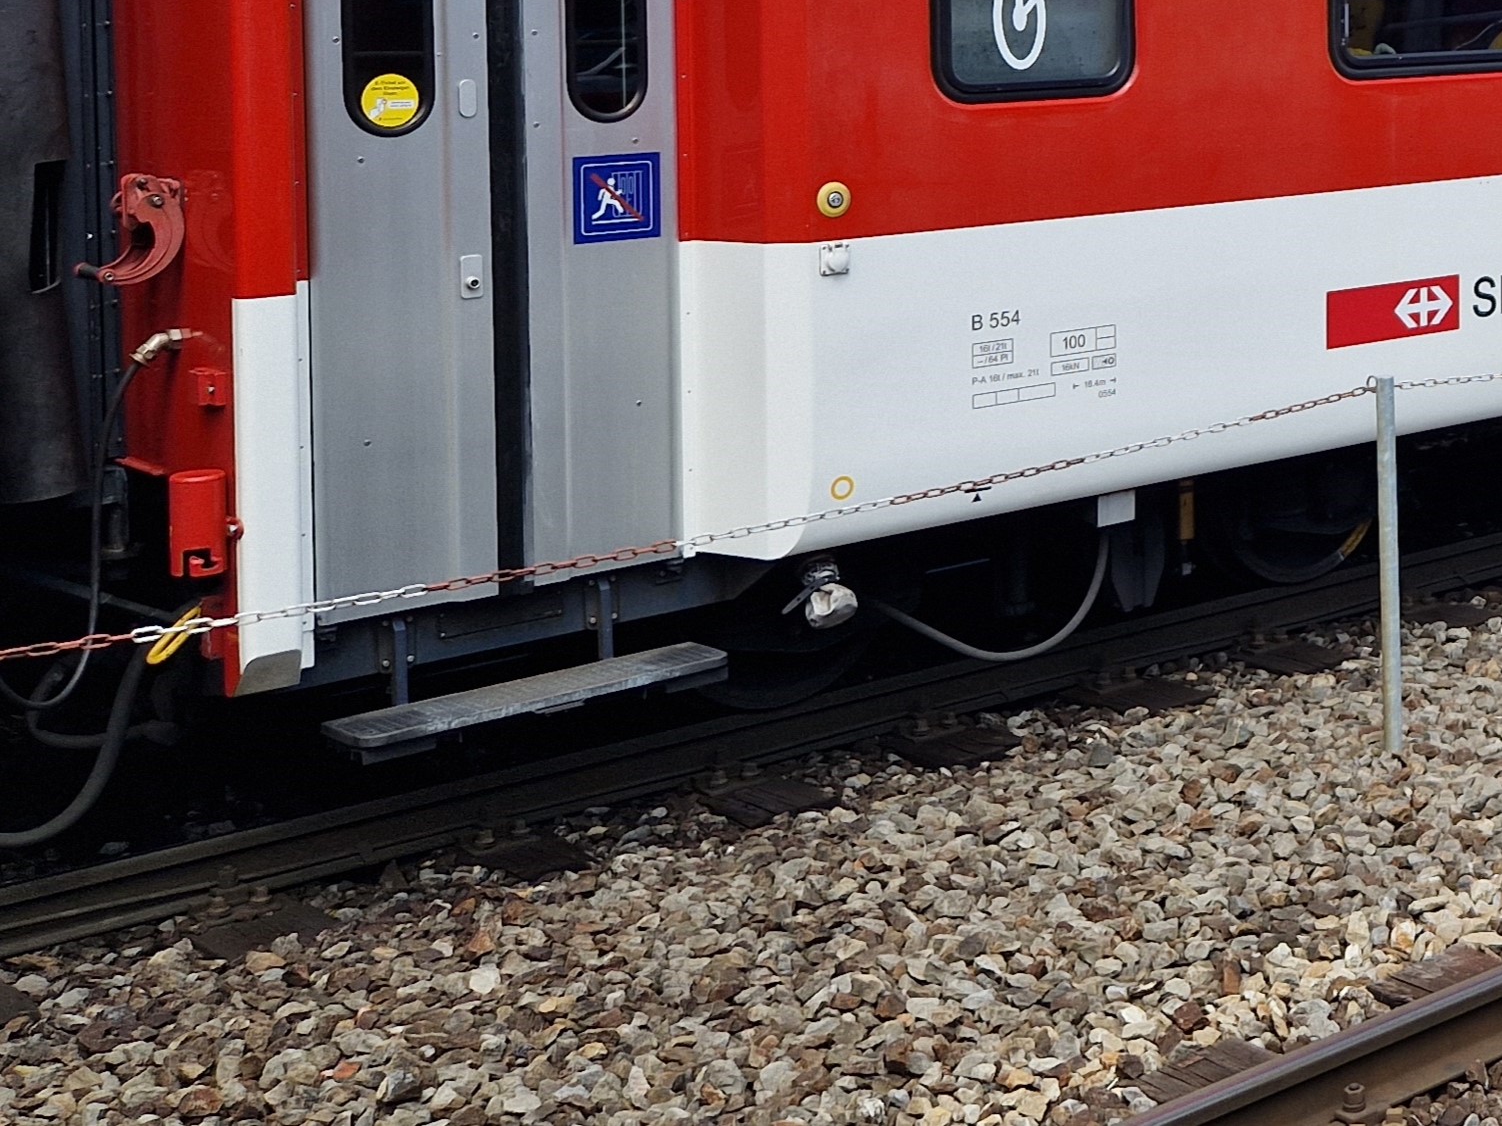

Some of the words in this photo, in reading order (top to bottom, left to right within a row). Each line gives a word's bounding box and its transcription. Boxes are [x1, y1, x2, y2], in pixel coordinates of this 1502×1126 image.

[971, 314, 984, 331] B
[989, 309, 1021, 329] 554
[1062, 334, 1086, 350] 100
